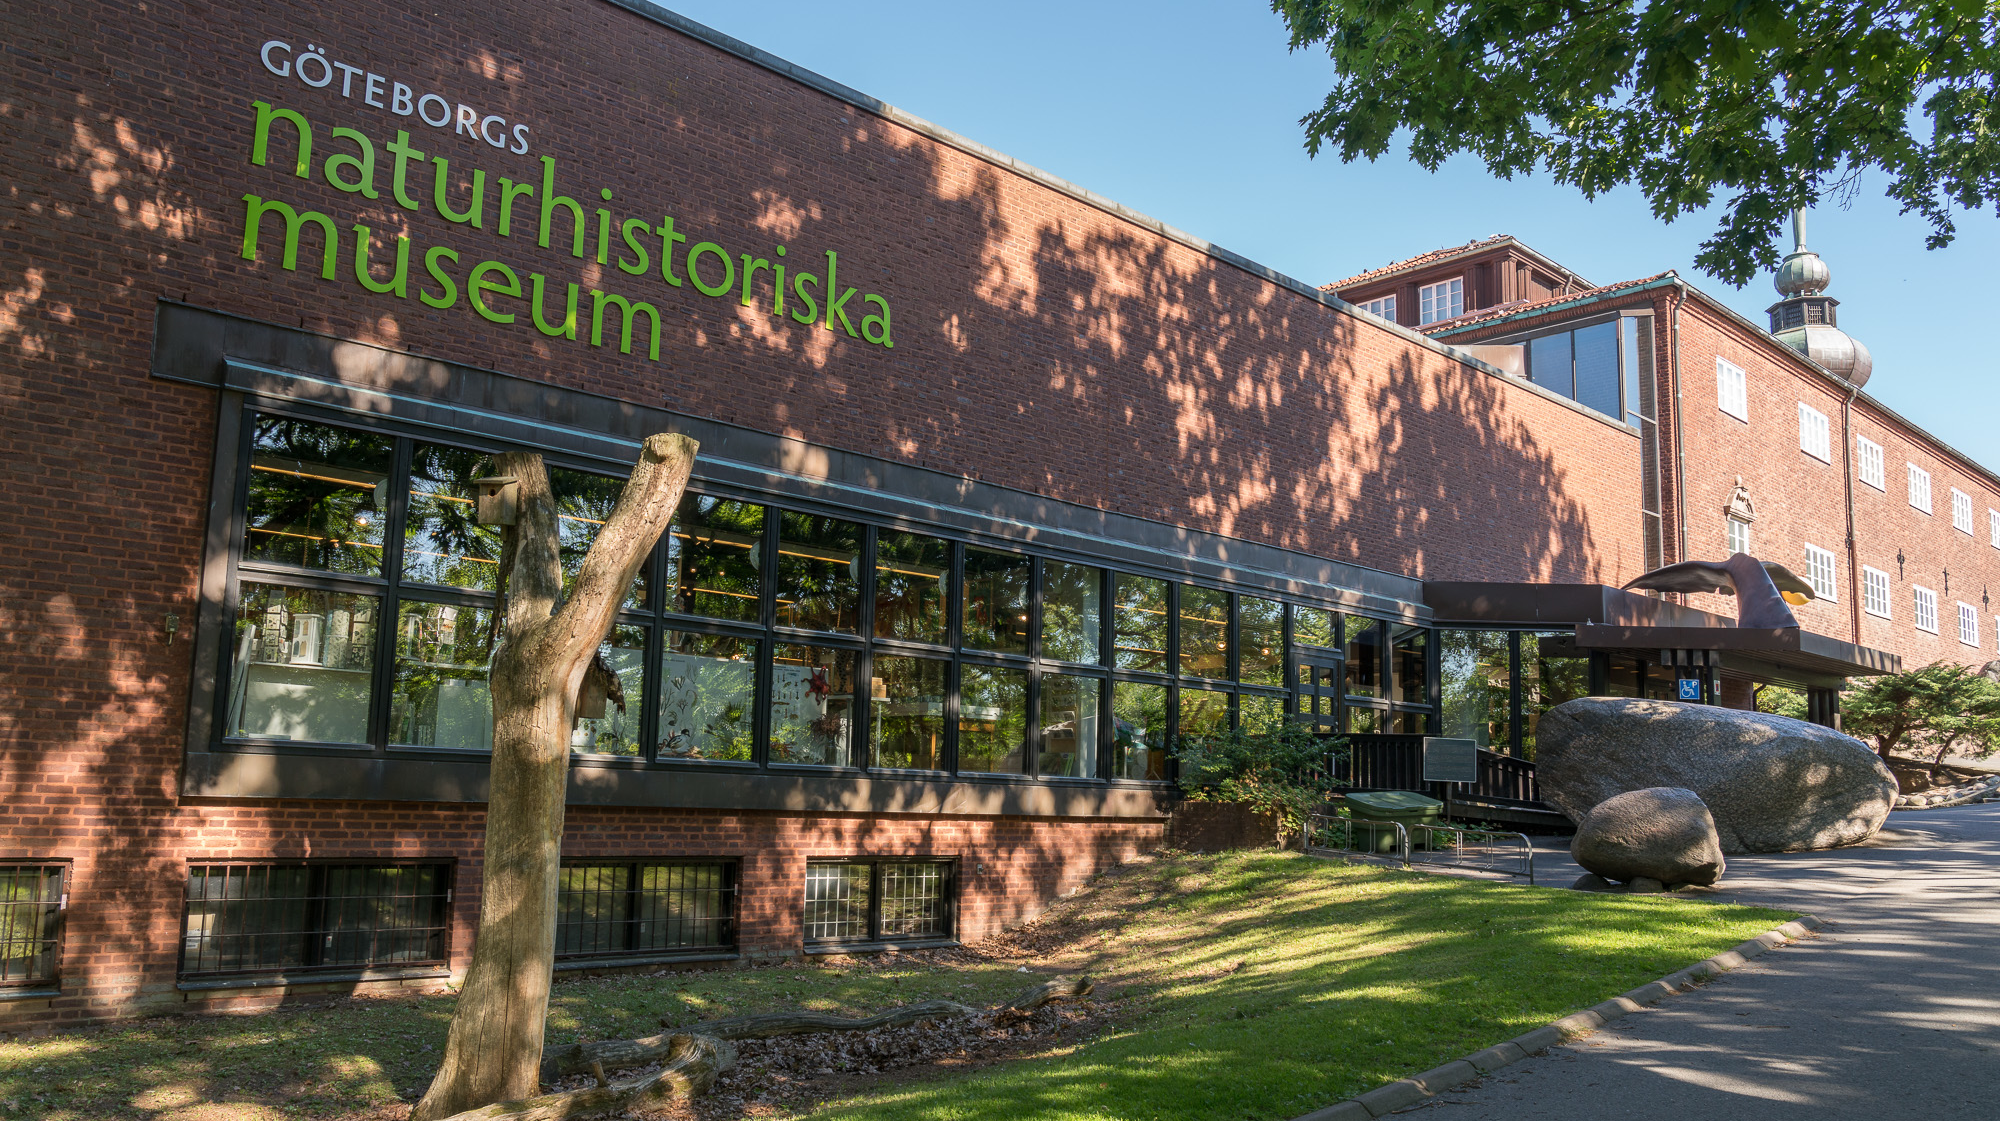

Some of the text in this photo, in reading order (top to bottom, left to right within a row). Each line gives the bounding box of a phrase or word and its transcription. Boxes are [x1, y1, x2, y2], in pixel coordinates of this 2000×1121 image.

[260, 40, 531, 155] GÖTEBORGS
[241, 192, 662, 362] museum
[251, 99, 894, 349] naturhistoriska
